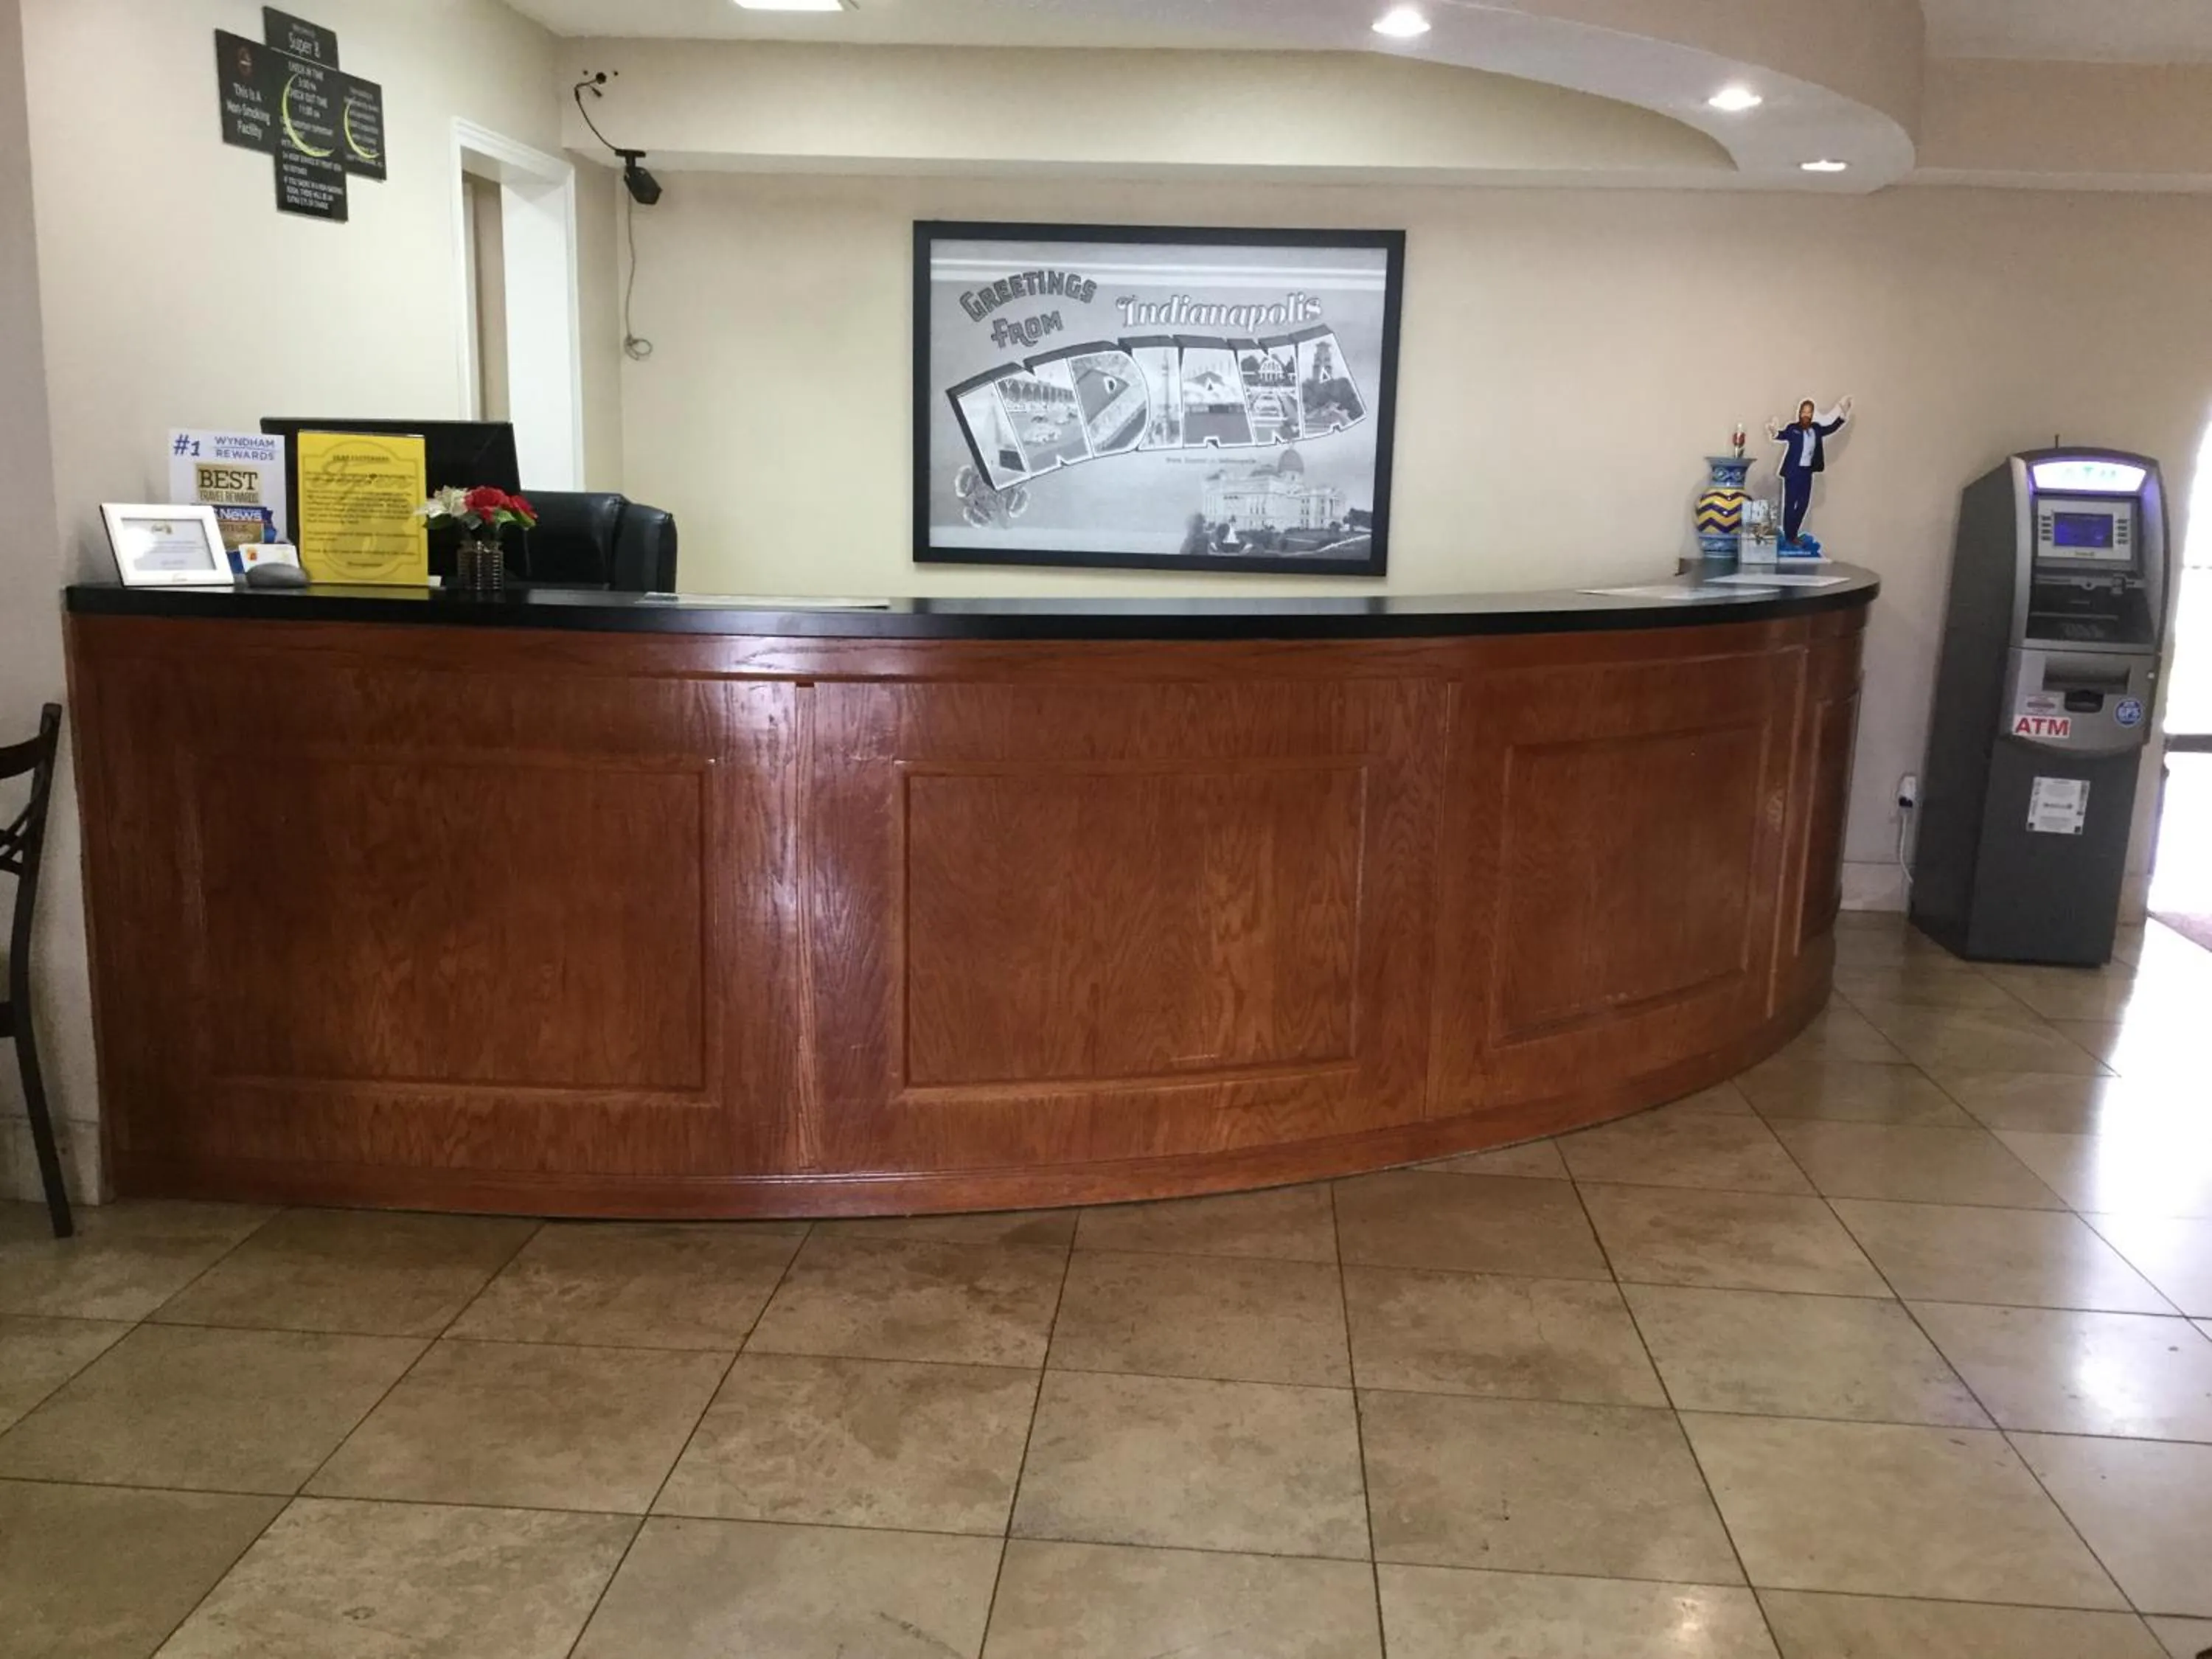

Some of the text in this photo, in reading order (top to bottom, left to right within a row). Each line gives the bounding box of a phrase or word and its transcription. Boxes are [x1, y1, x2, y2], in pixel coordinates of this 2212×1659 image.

[959, 269, 1098, 322] GREETINGS
[1116, 291, 1322, 333] Indianapolis
[990, 310, 1065, 349] FROM
[173, 434, 201, 457] #1
[214, 436, 276, 448] WYNDHAM
[215, 449, 275, 462] REWARDS
[198, 469, 259, 490] BEST
[2015, 717, 2070, 736] ATM
